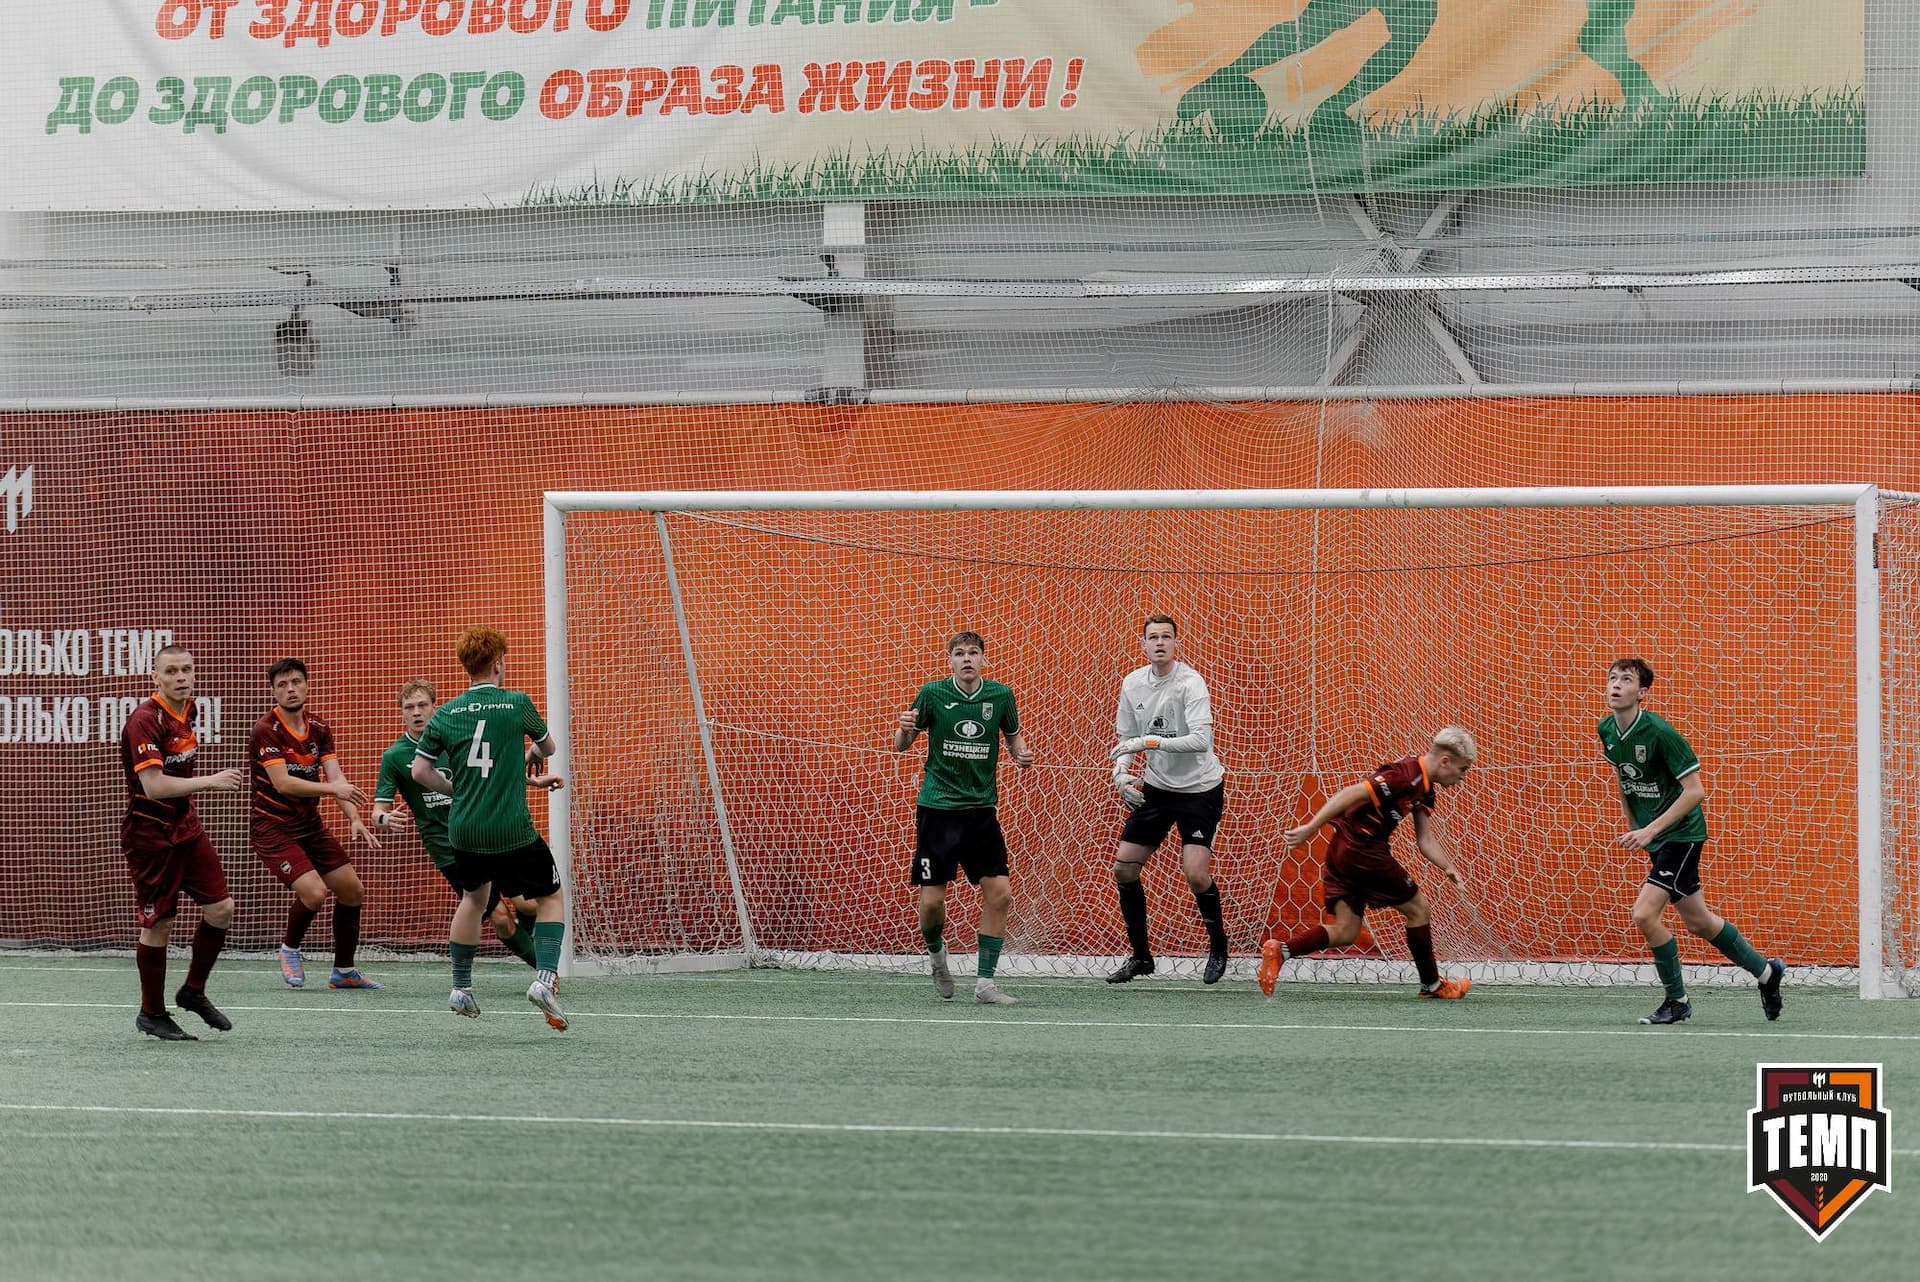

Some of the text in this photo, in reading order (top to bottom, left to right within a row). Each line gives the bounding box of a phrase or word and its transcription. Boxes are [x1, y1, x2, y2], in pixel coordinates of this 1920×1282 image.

[155, 0, 238, 39] ОТ
[248, 0, 630, 48] ЗДОРОВОГО
[45, 76, 140, 135] ДО
[148, 70, 525, 135] ЗДОРОВОГО
[539, 64, 785, 119] ОБРАЗА
[467, 719, 493, 778] 4
[920, 857, 932, 880] 3
